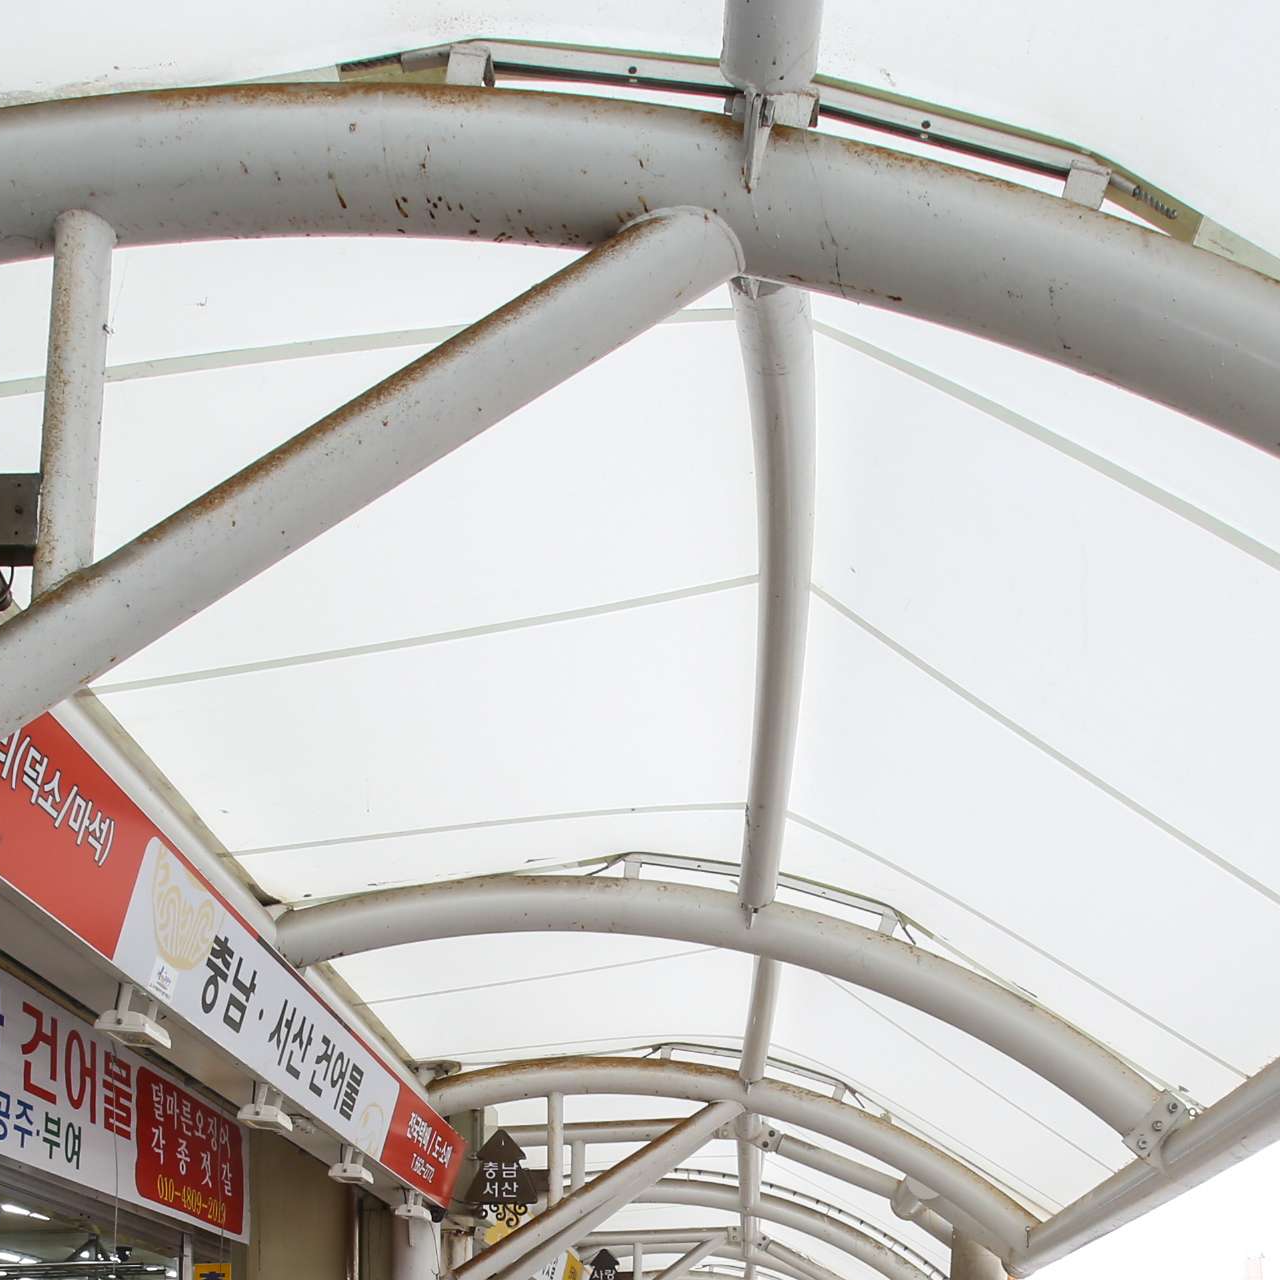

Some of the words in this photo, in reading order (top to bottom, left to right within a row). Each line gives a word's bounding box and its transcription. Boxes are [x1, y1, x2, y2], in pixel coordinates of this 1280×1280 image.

[21, 1002, 133, 1141] 건어물
[310, 1034, 365, 1122] 건어물
[151, 1083, 231, 1159] 덜마른오징어
[483, 1162, 521, 1180] 충남
[483, 1182, 519, 1198] 서산
[592, 1269, 616, 1280] 사랑
